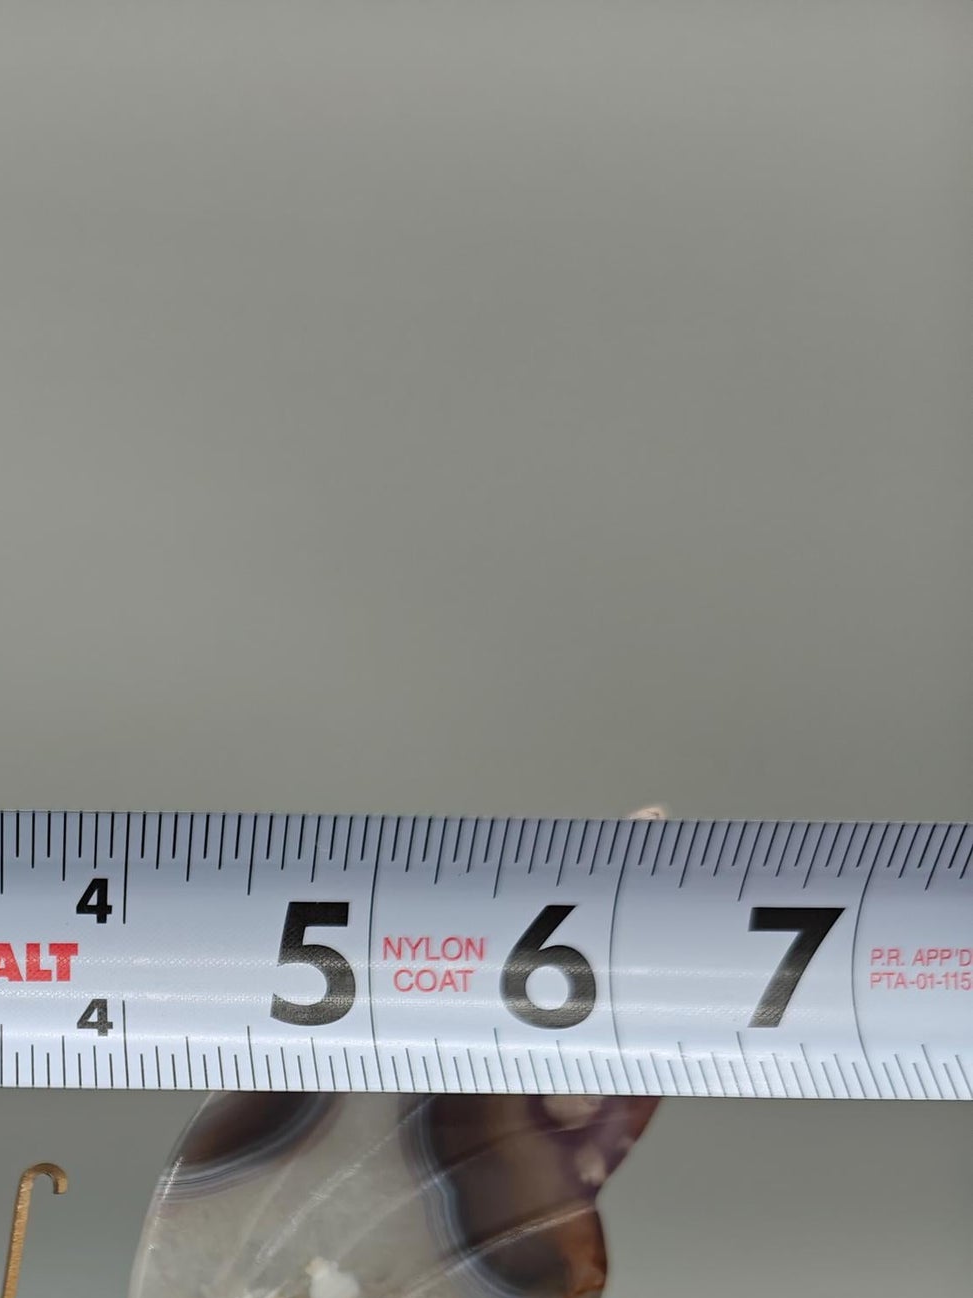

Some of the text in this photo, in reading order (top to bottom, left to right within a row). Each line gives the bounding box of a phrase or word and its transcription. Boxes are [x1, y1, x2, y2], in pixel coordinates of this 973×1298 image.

[76, 878, 113, 924] 4
[270, 901, 356, 1026] 5
[382, 937, 487, 961] NYLON
[499, 905, 597, 1029] 6
[747, 907, 846, 1028] 7
[870, 948, 905, 967] P.R.
[393, 969, 476, 992] COAT
[77, 999, 113, 1036] 4
